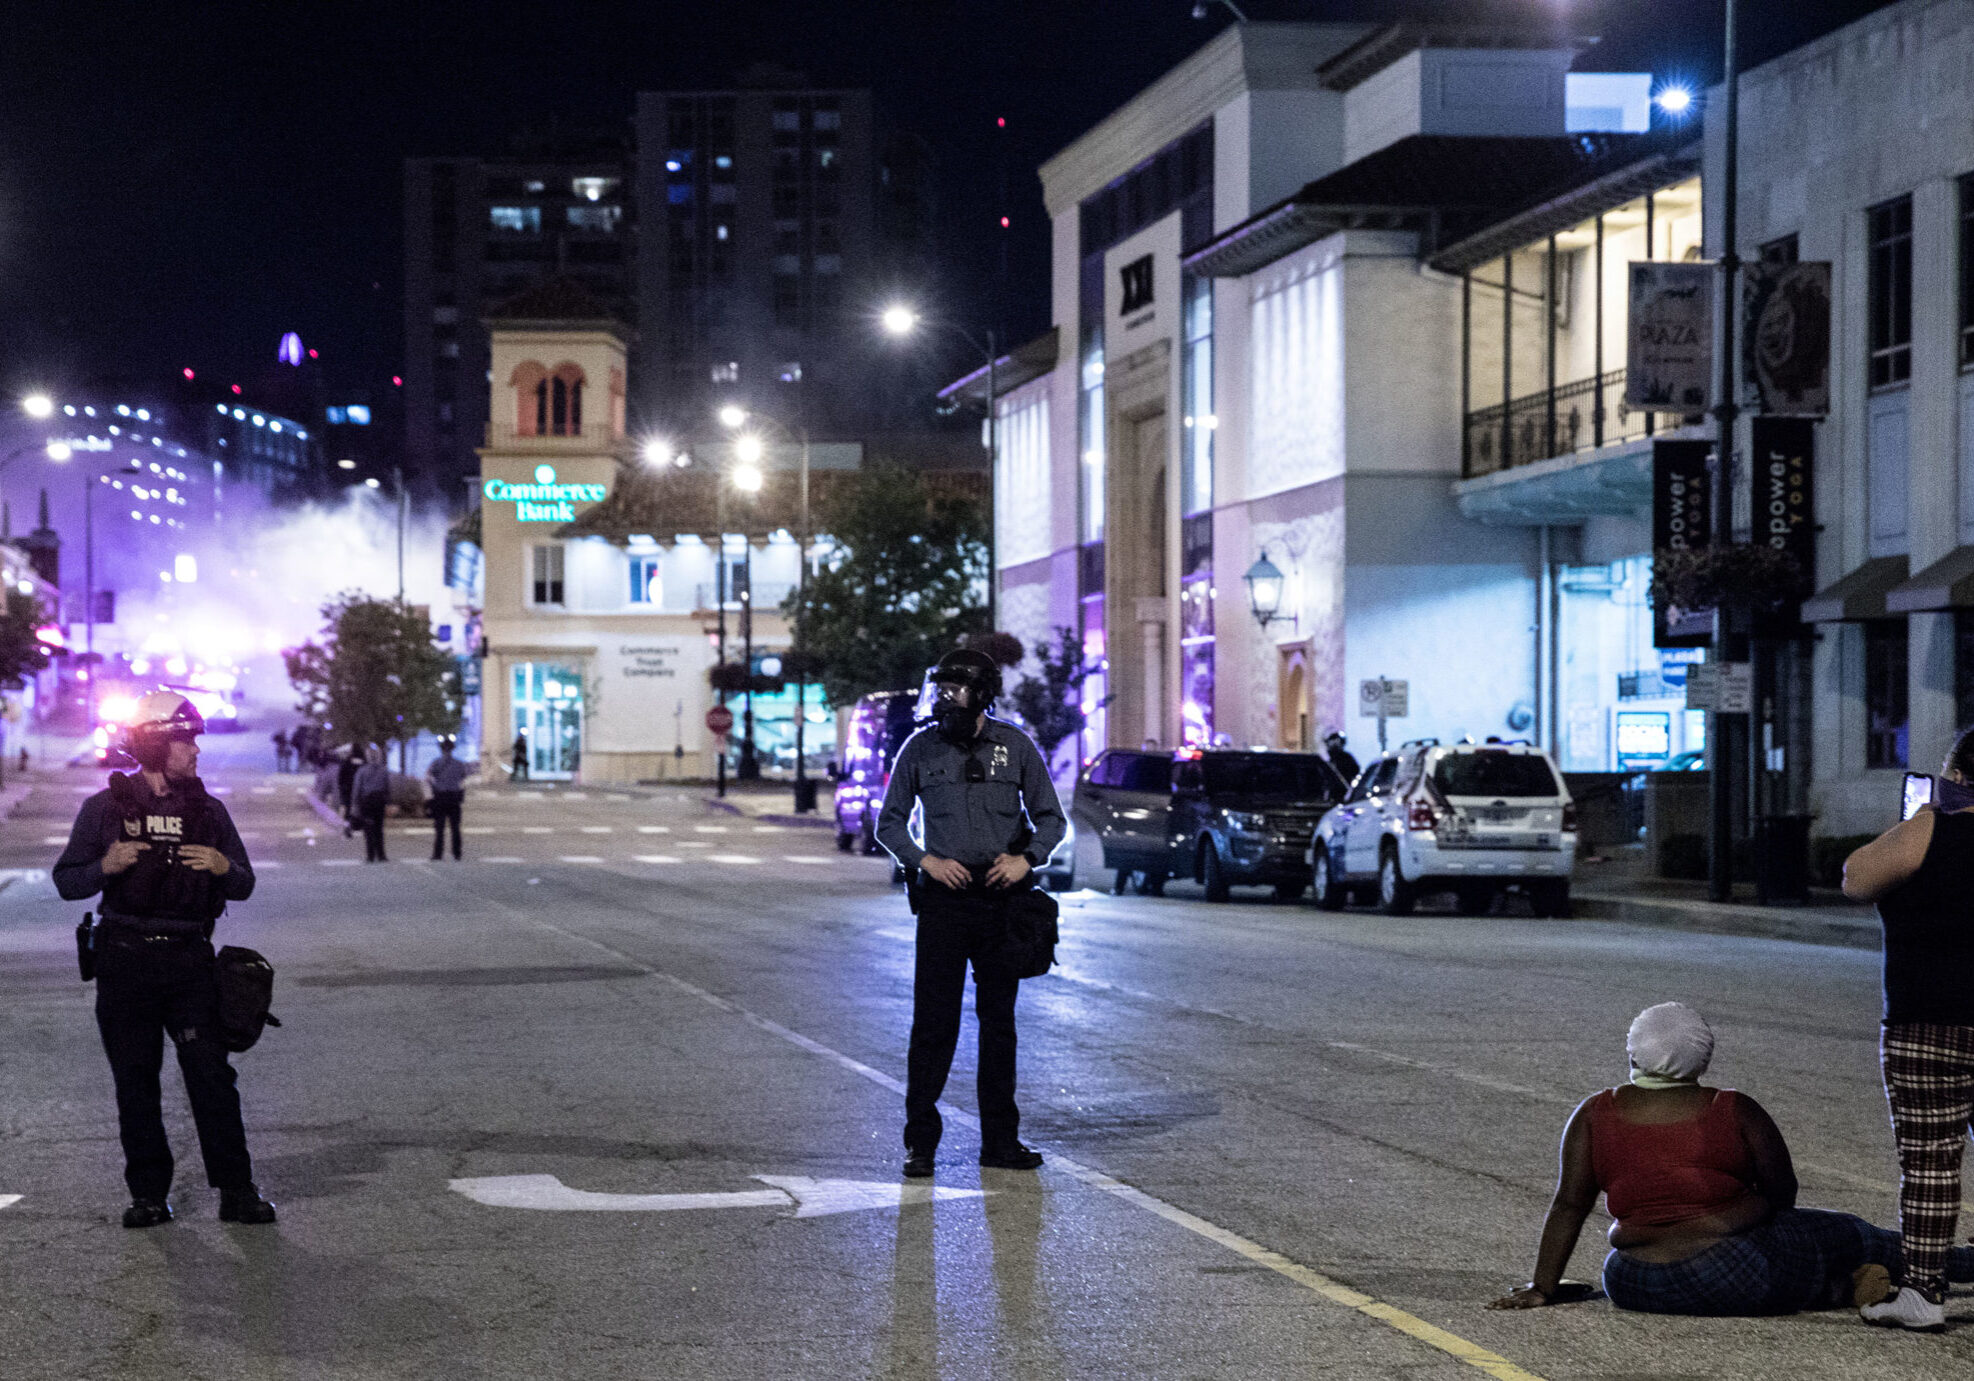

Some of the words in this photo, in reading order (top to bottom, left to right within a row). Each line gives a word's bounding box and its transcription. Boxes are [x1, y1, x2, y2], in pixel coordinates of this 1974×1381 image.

[1639, 322, 1698, 345] PLAZA
[484, 479, 606, 501] Commerce
[1790, 456, 1803, 525] YOGA
[517, 500, 576, 522] Bank
[1689, 477, 1701, 538] YOGA
[620, 645, 679, 655] Commerce
[623, 668, 675, 678] Company
[146, 815, 183, 835] POLICE
